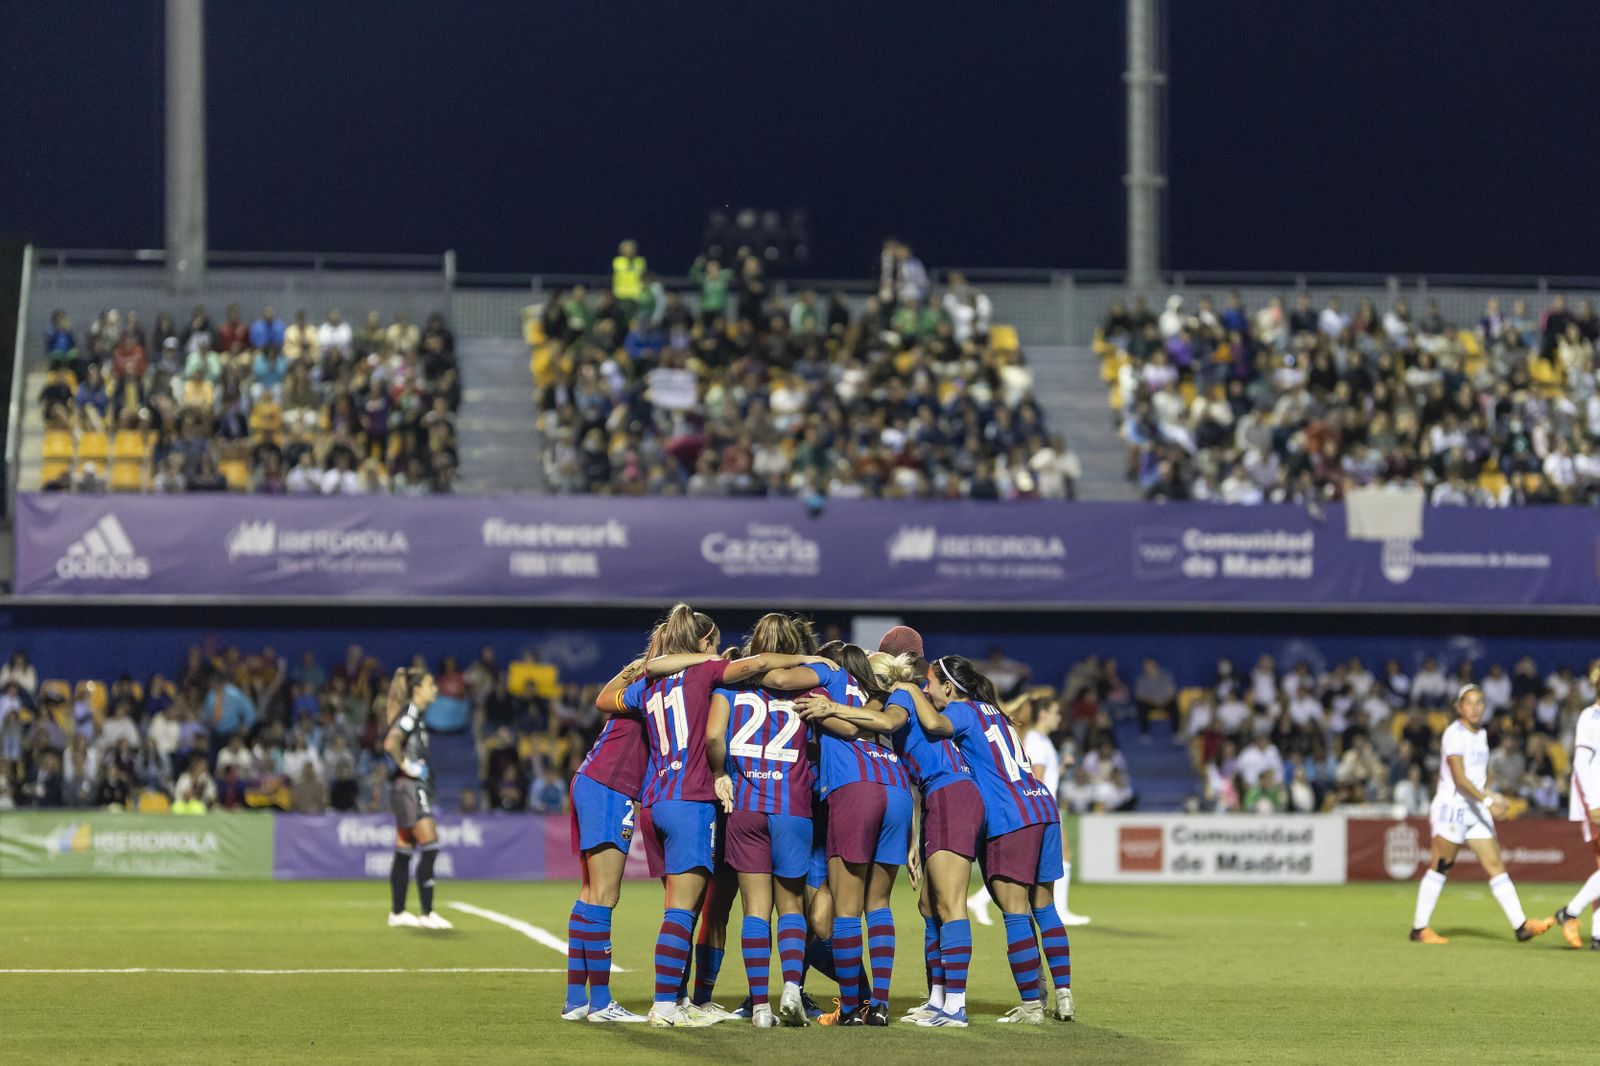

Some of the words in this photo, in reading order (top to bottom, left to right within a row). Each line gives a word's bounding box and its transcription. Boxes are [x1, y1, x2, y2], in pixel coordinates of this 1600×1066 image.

[277, 530, 409, 554] IBERDROLA
[938, 536, 1066, 560] IBERDROLA
[1183, 530, 1314, 552] Comunidad
[56, 557, 151, 580] adidas
[1182, 556, 1216, 579] de
[1222, 555, 1314, 579] Madrid
[646, 685, 689, 756] 11
[729, 693, 800, 763] 22
[984, 724, 1032, 783] 14
[743, 769, 772, 779] unicef
[94, 831, 217, 852] IBERDROLA
[1172, 826, 1314, 844] Comunidad
[1171, 855, 1202, 873] de
[1215, 854, 1312, 874] Madrid
